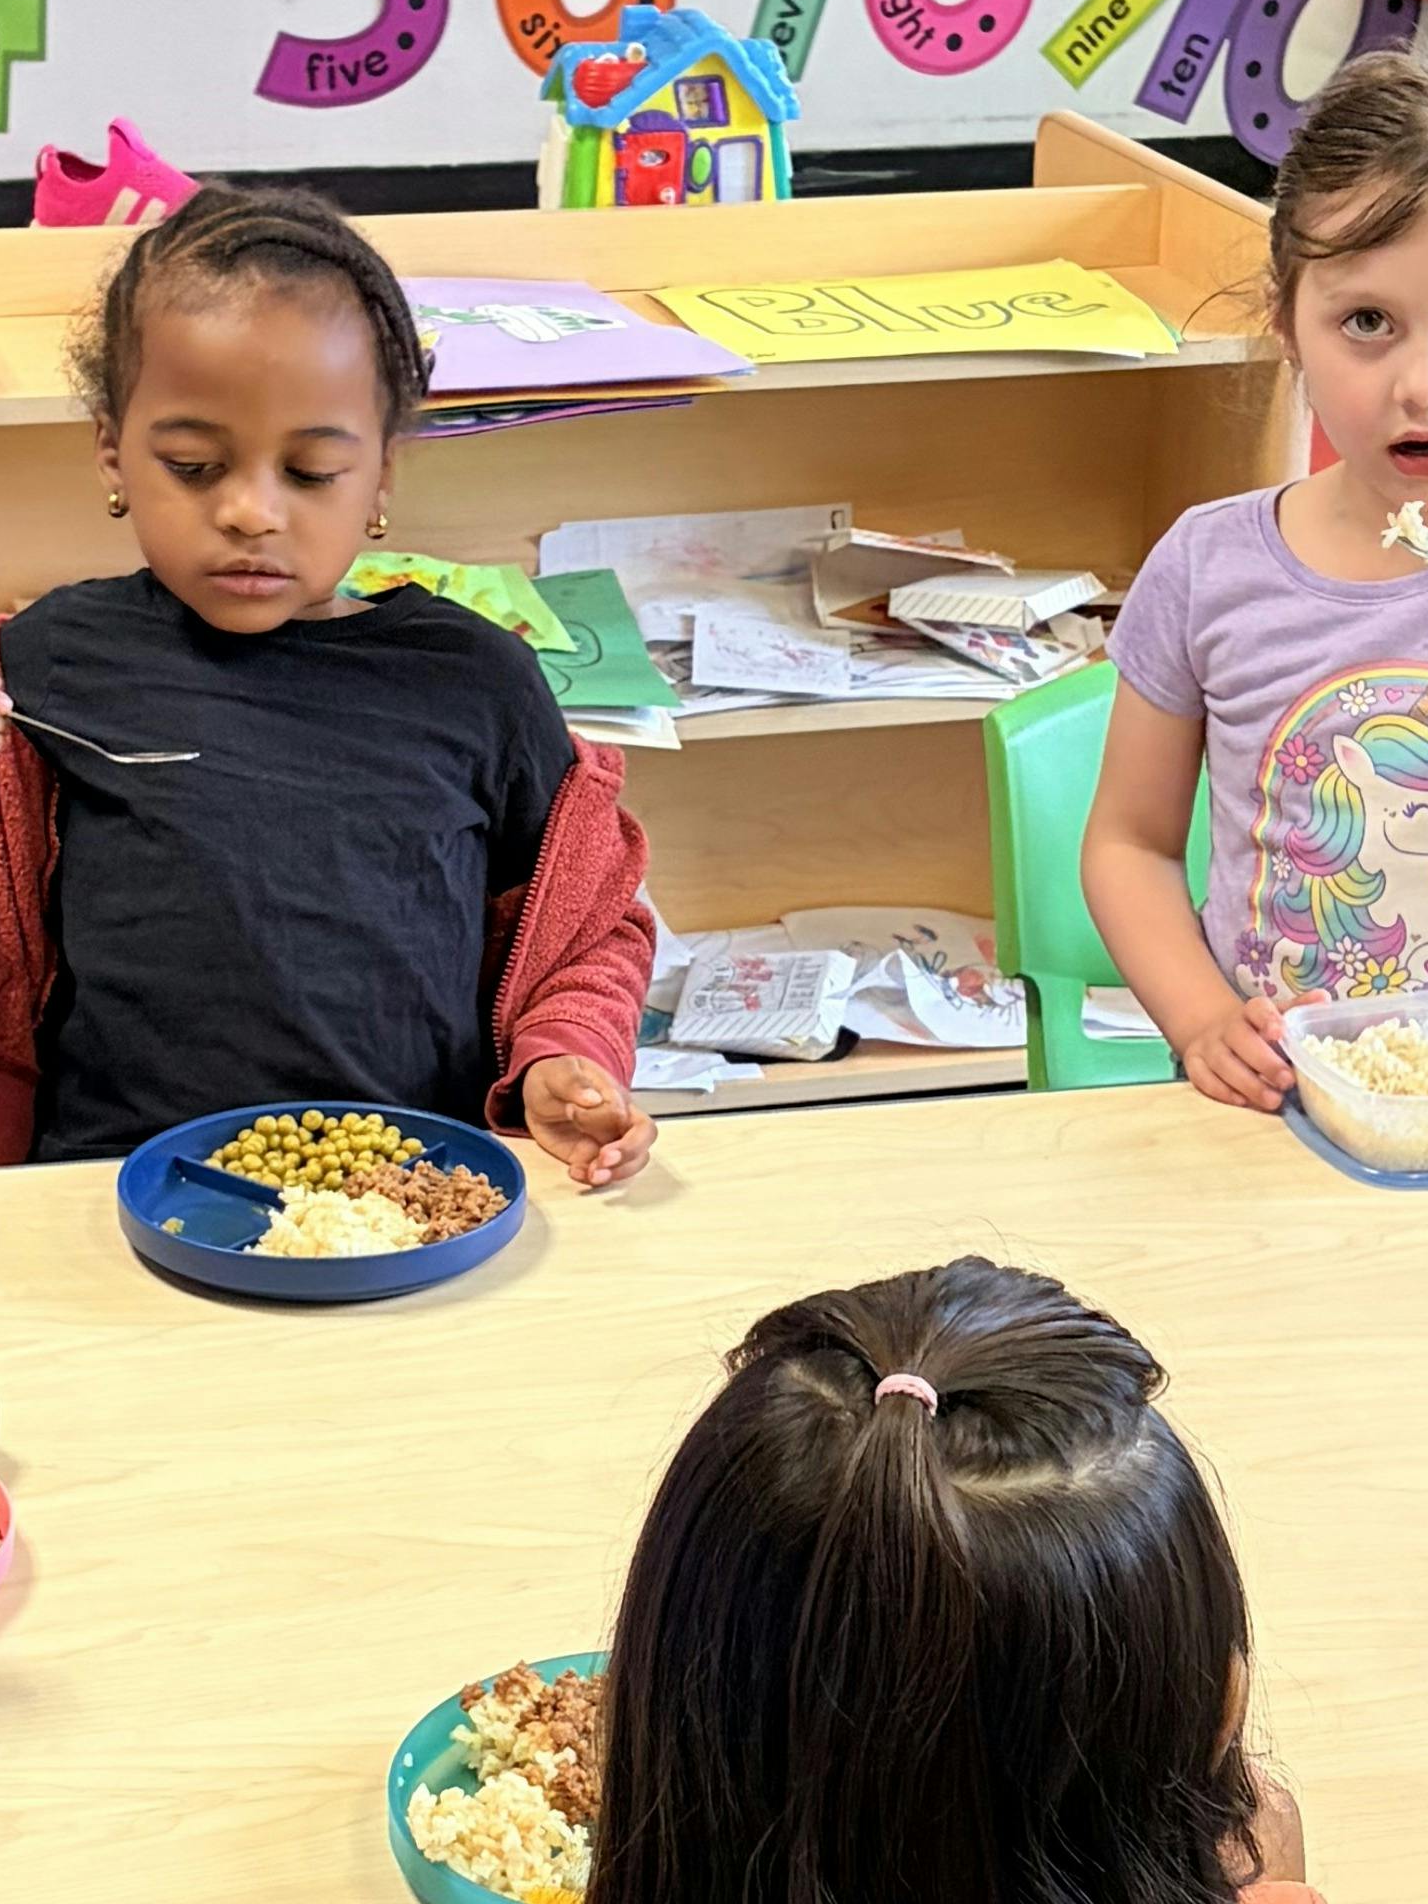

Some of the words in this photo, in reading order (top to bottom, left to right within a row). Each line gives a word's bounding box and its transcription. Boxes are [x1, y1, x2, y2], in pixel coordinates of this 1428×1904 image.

[305, 46, 390, 91] five
[1159, 31, 1211, 97] ten
[695, 285, 1109, 336] Blue
